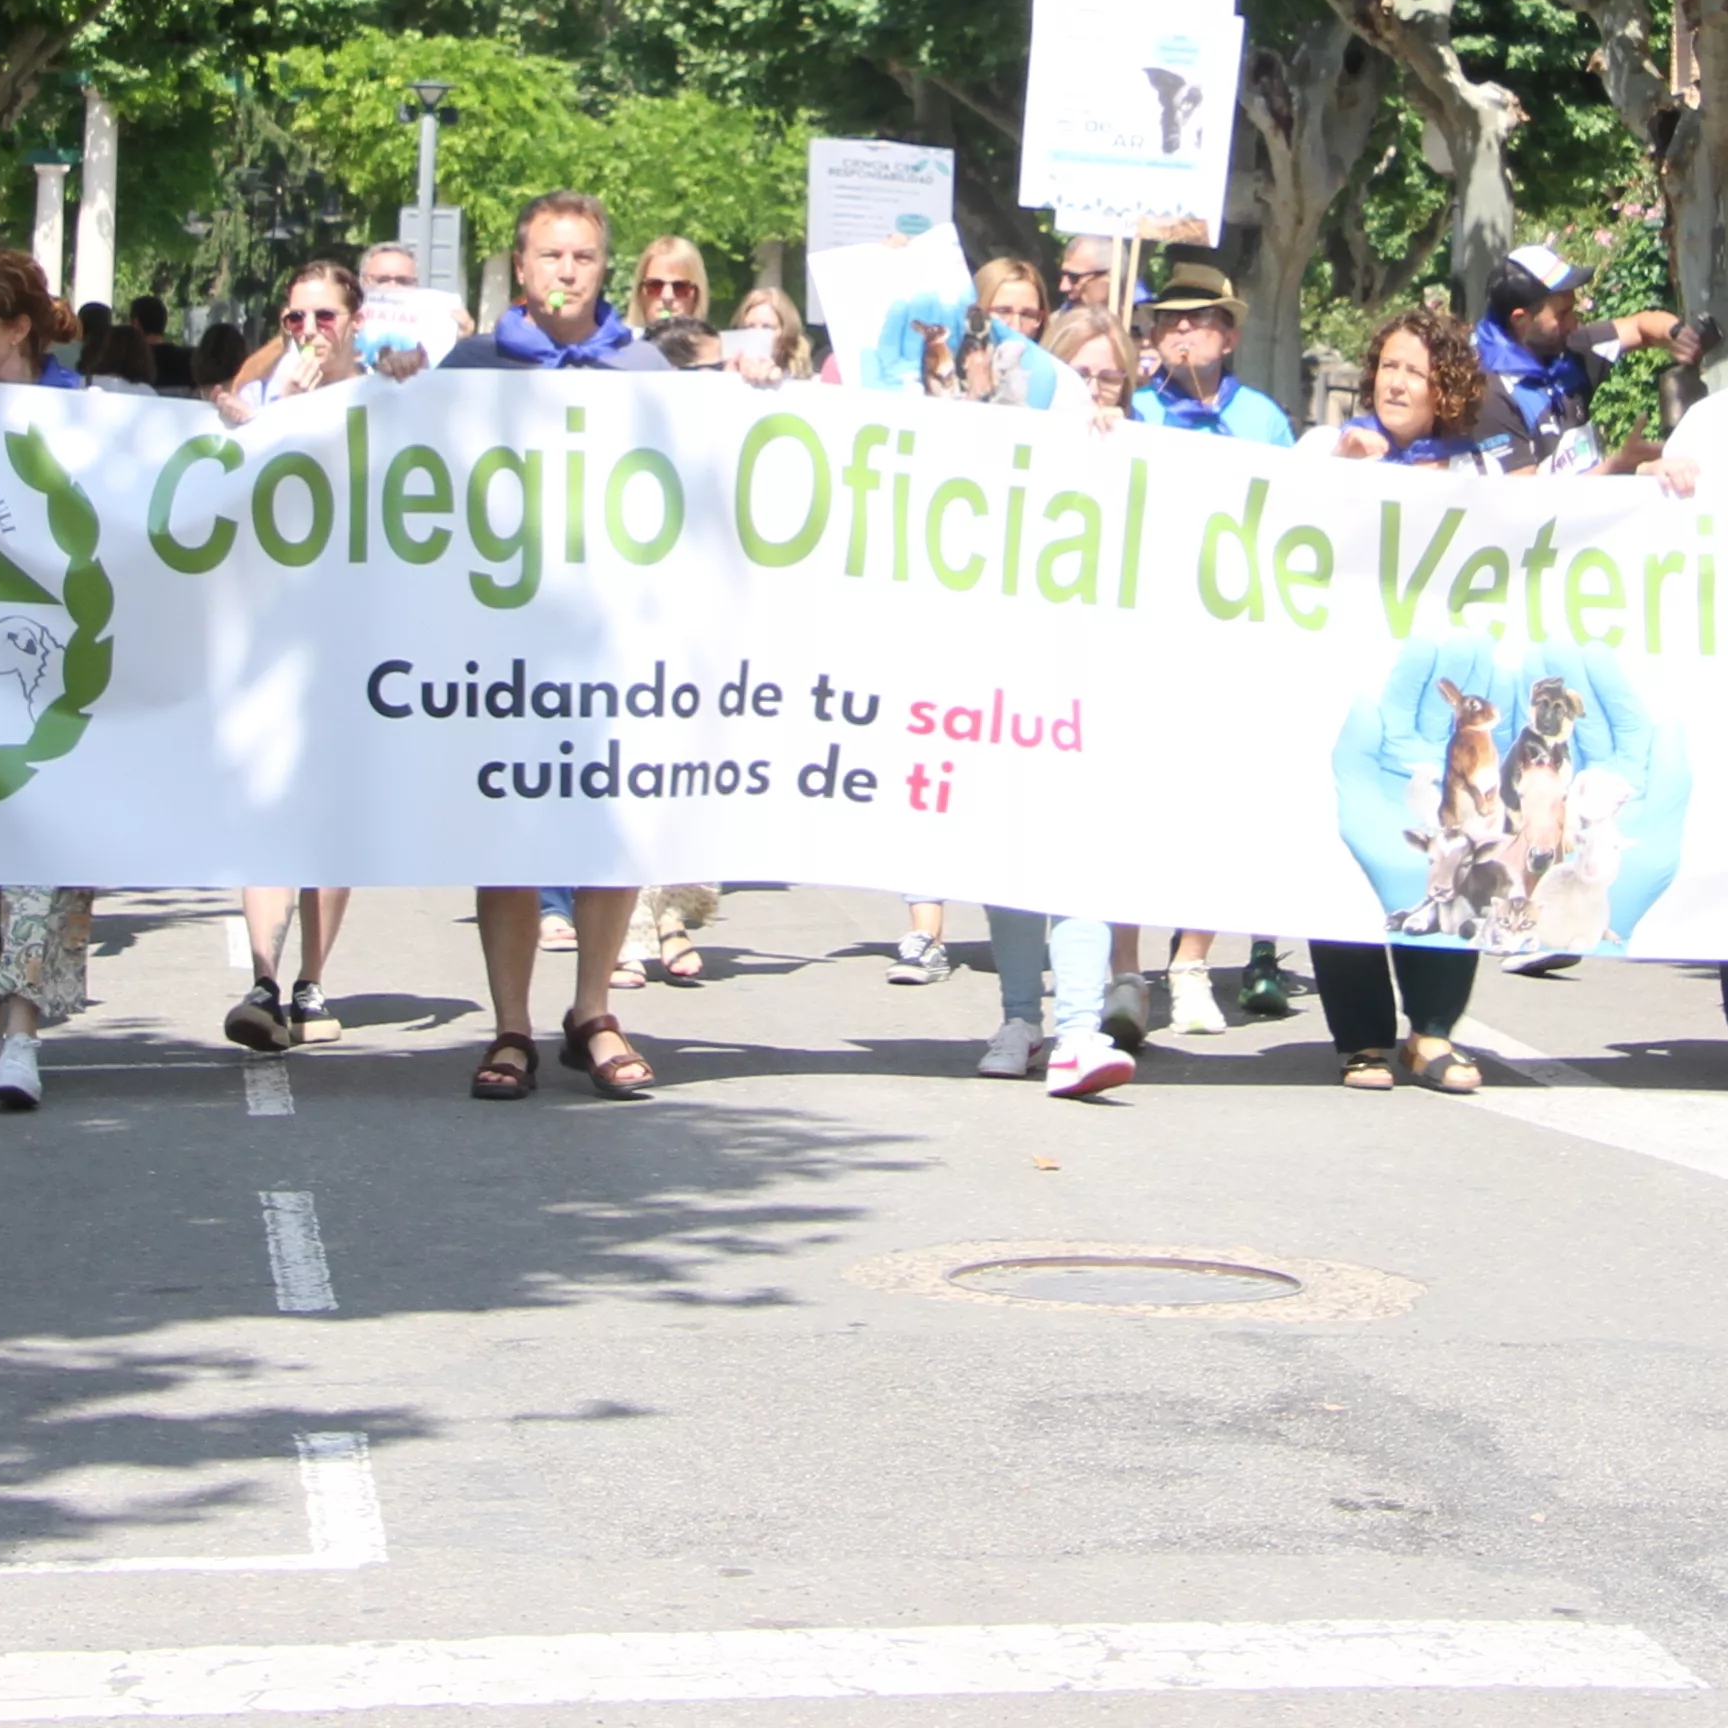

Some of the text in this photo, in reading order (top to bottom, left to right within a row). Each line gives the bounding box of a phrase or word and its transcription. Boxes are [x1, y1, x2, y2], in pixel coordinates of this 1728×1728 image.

[150, 405, 684, 609] Colegio
[735, 408, 1149, 609] Oficial
[1198, 479, 1335, 633] de
[365, 658, 1085, 753] Cuidando de tu salud
[476, 740, 956, 815] cuidamos de ti
